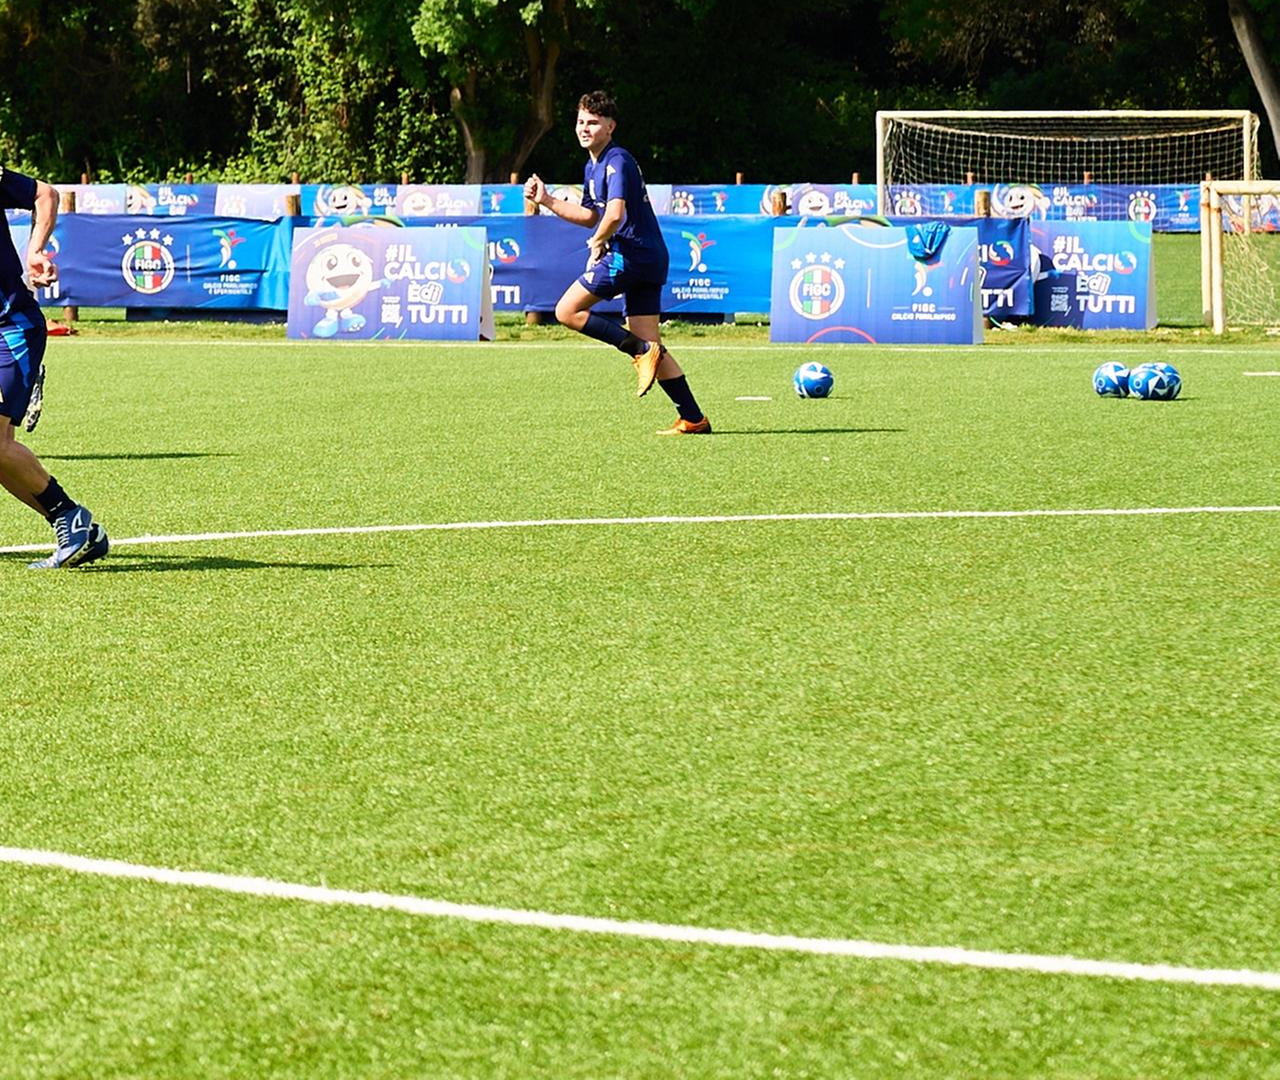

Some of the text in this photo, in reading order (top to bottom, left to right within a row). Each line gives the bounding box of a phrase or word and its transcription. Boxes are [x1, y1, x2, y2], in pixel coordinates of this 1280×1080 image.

[386, 243, 416, 262] #IL
[1053, 235, 1084, 254] #IL
[490, 285, 521, 304] TTI
[803, 283, 831, 297] FIGC
[981, 288, 1014, 308] TTI
[1075, 294, 1136, 313] TUTTI
[407, 305, 468, 324] TUTTI
